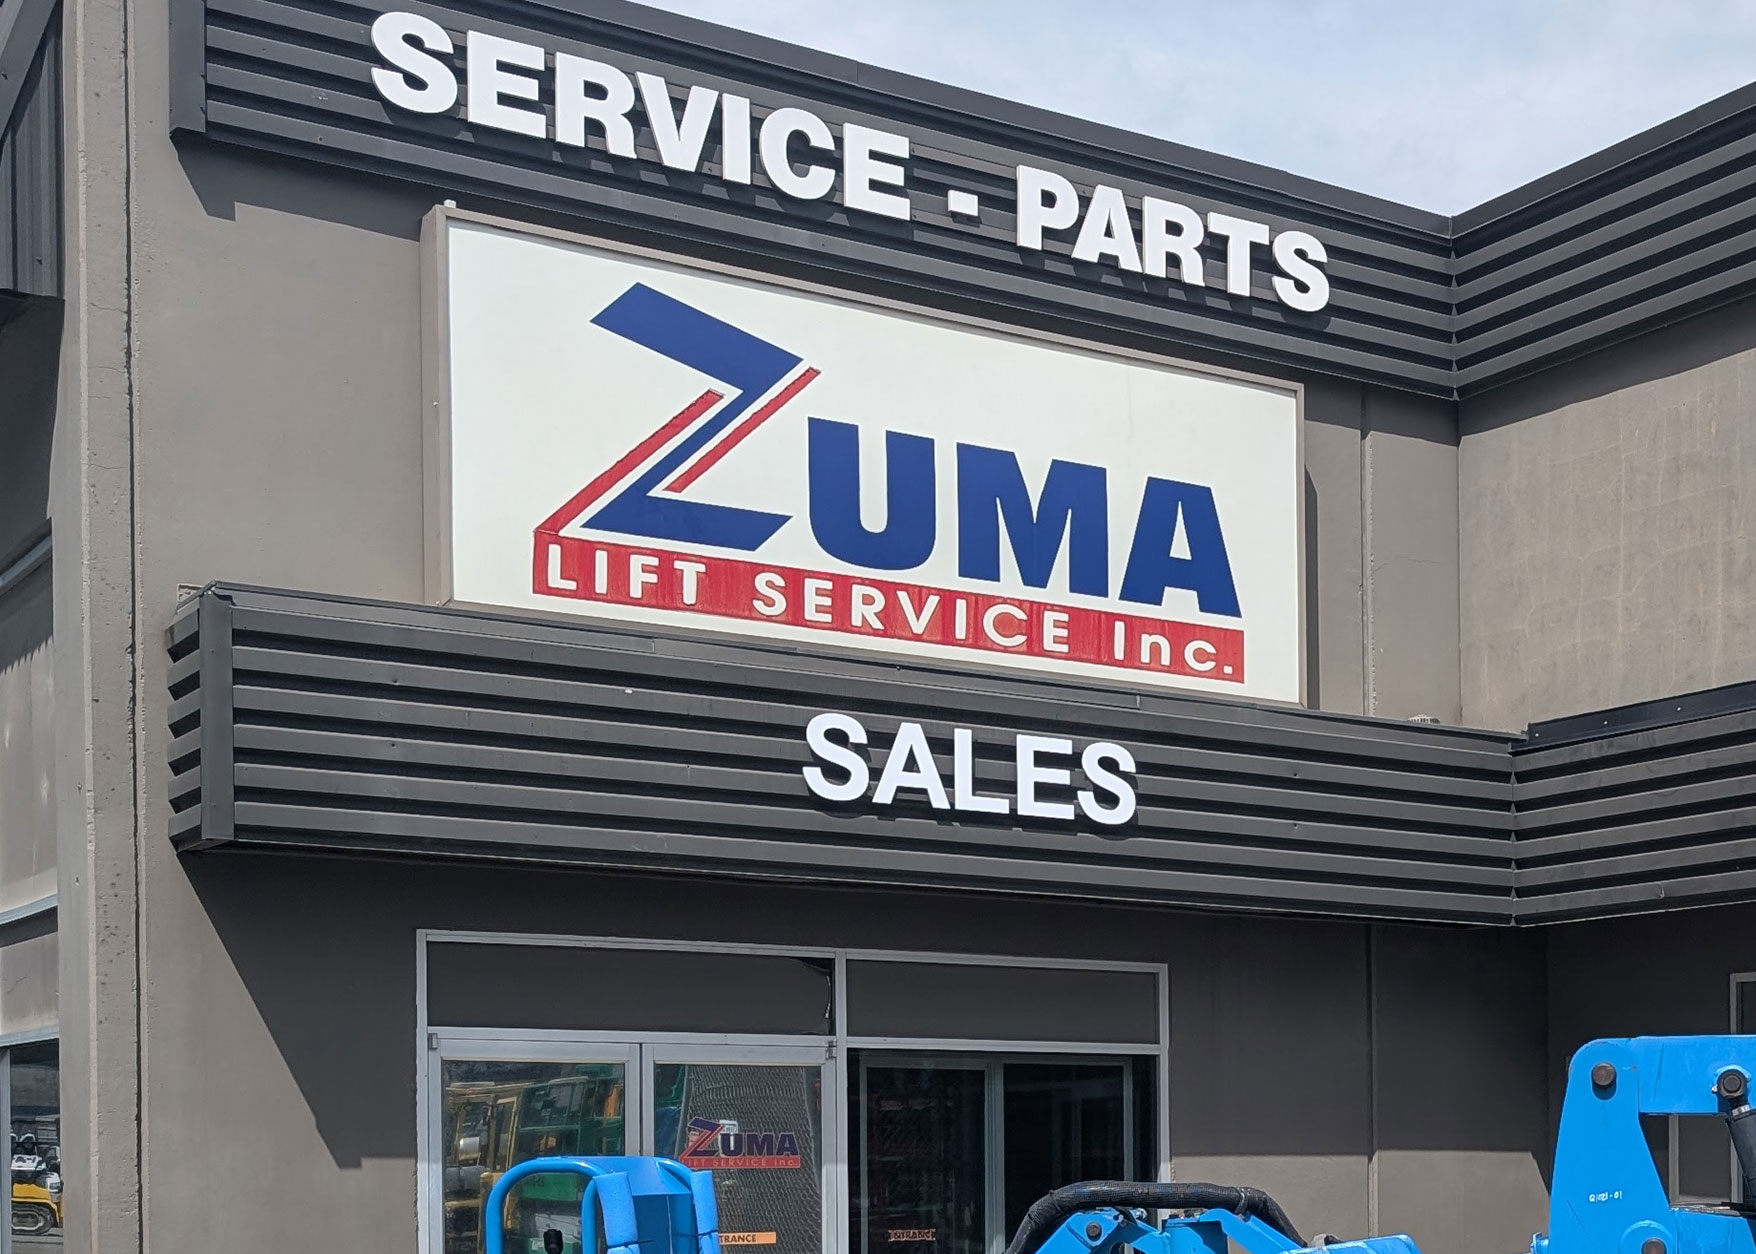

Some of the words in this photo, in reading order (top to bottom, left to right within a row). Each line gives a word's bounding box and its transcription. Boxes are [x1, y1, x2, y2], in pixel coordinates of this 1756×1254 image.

[370, 11, 912, 222] SERVICE
[1015, 164, 1331, 313] PARTS
[576, 281, 1244, 619] ZUMA
[546, 543, 708, 606] LIFT
[752, 570, 1072, 655] SERVICE
[1113, 618, 1235, 677] Inc.
[802, 712, 1138, 826] SALES
[686, 1116, 800, 1158] ZUMA
[712, 1157, 769, 1168] SERVICE
[773, 1157, 799, 1168] Inc.
